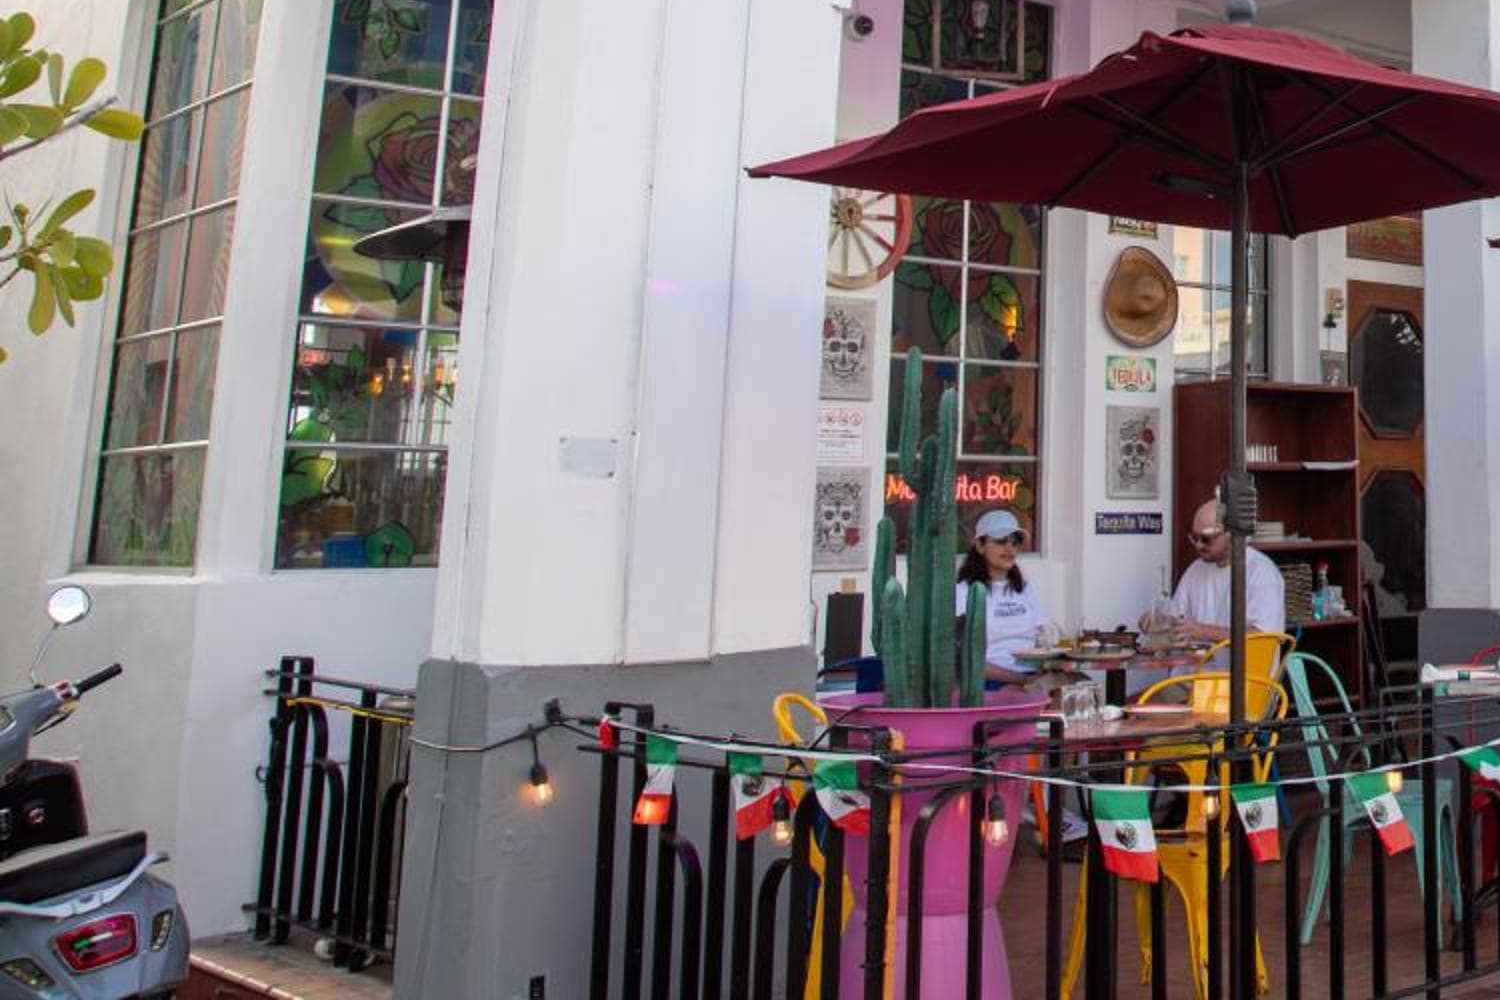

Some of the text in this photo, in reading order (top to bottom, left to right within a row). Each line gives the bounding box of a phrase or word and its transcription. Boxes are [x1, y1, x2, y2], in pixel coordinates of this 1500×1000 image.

[1111, 366, 1152, 385] TEQUILA
[986, 474, 1020, 500] Bar
[1097, 515, 1161, 532] Tequila Way
